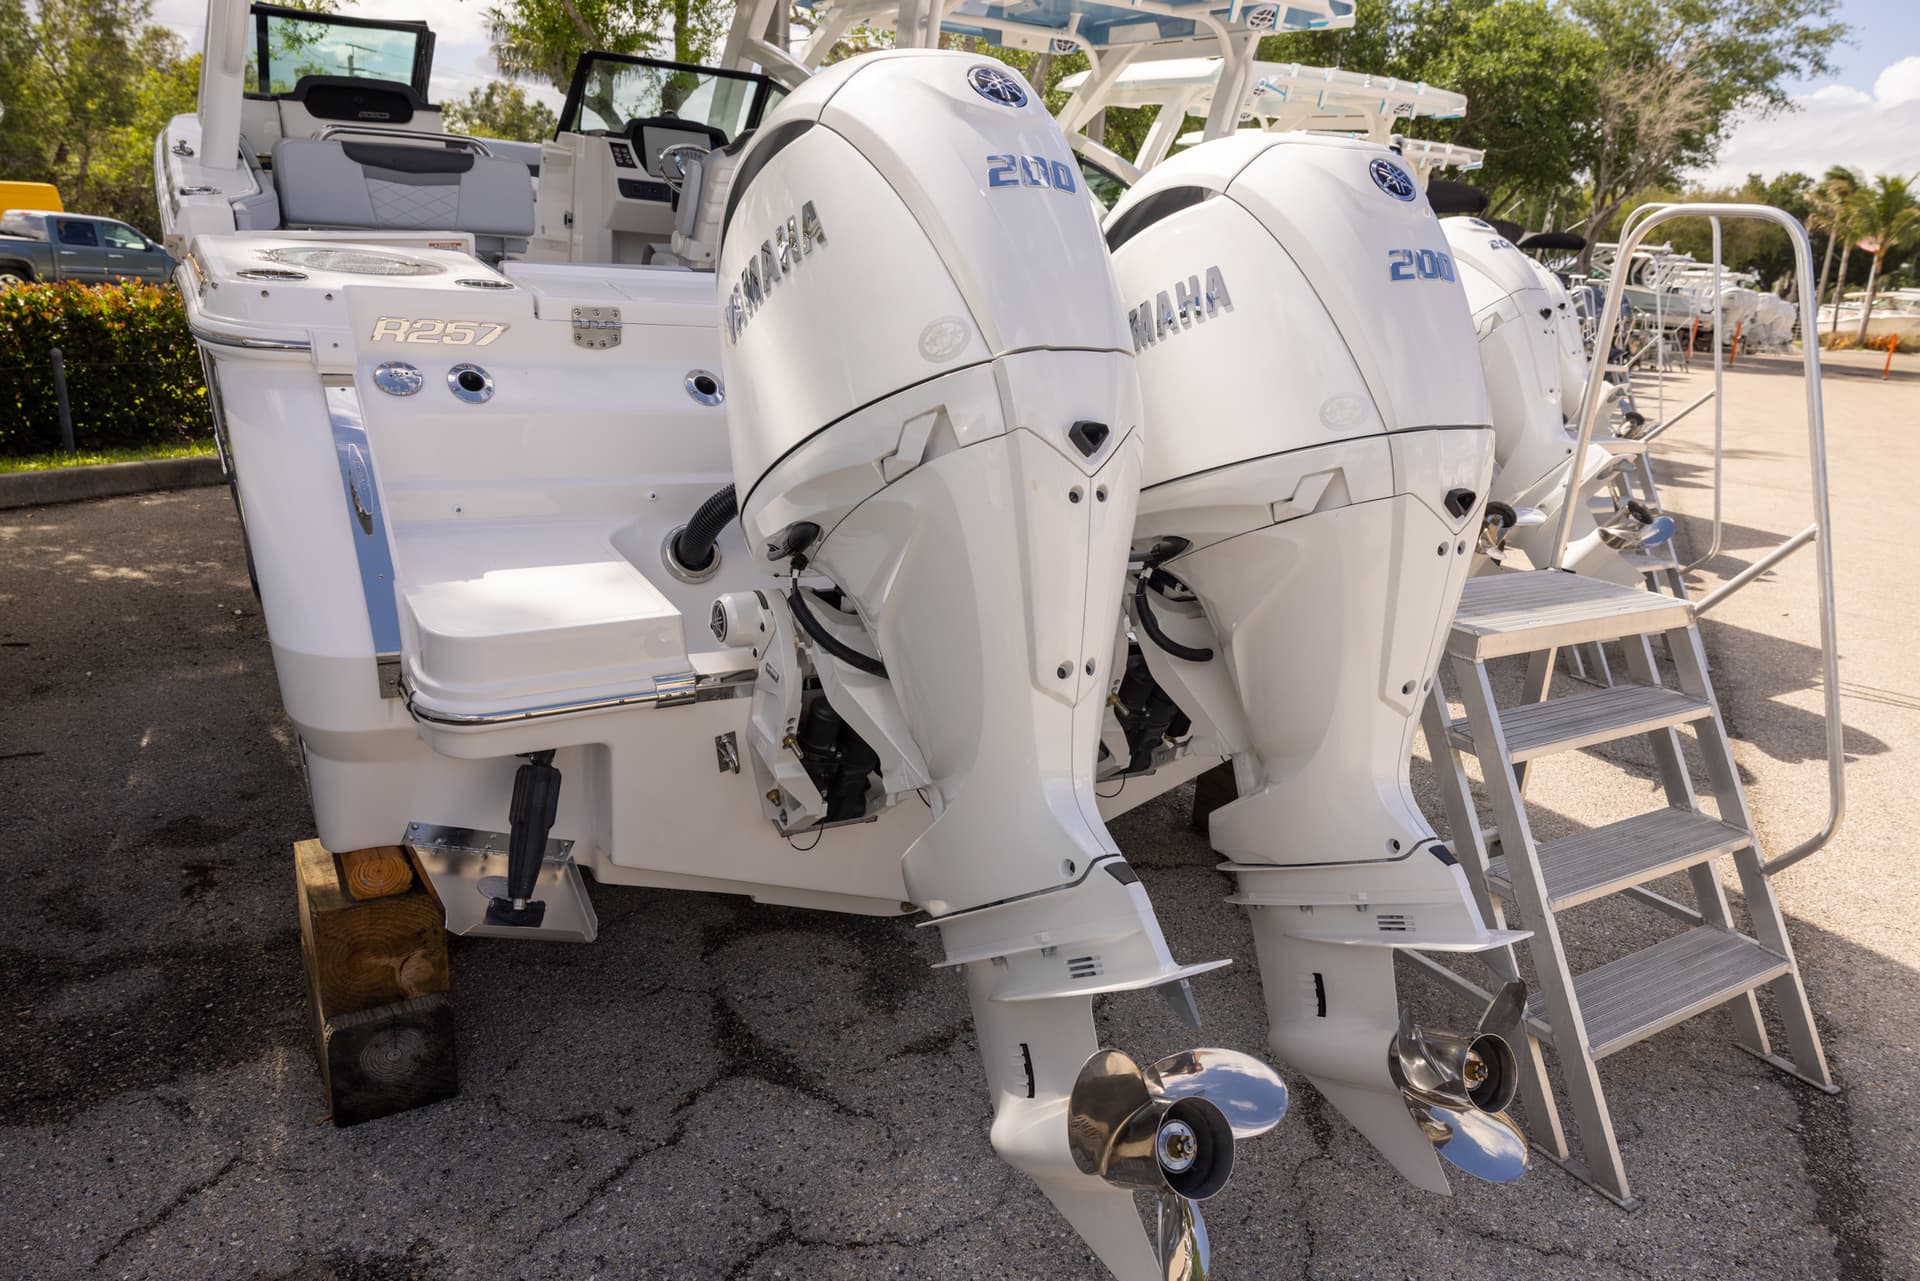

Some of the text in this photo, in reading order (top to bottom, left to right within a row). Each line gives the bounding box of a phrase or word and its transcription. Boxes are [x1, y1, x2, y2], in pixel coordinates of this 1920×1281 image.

[986, 154, 1077, 194] 200
[725, 200, 829, 347] YAMAHA
[1388, 248, 1455, 283] 200
[371, 316, 511, 346] R257
